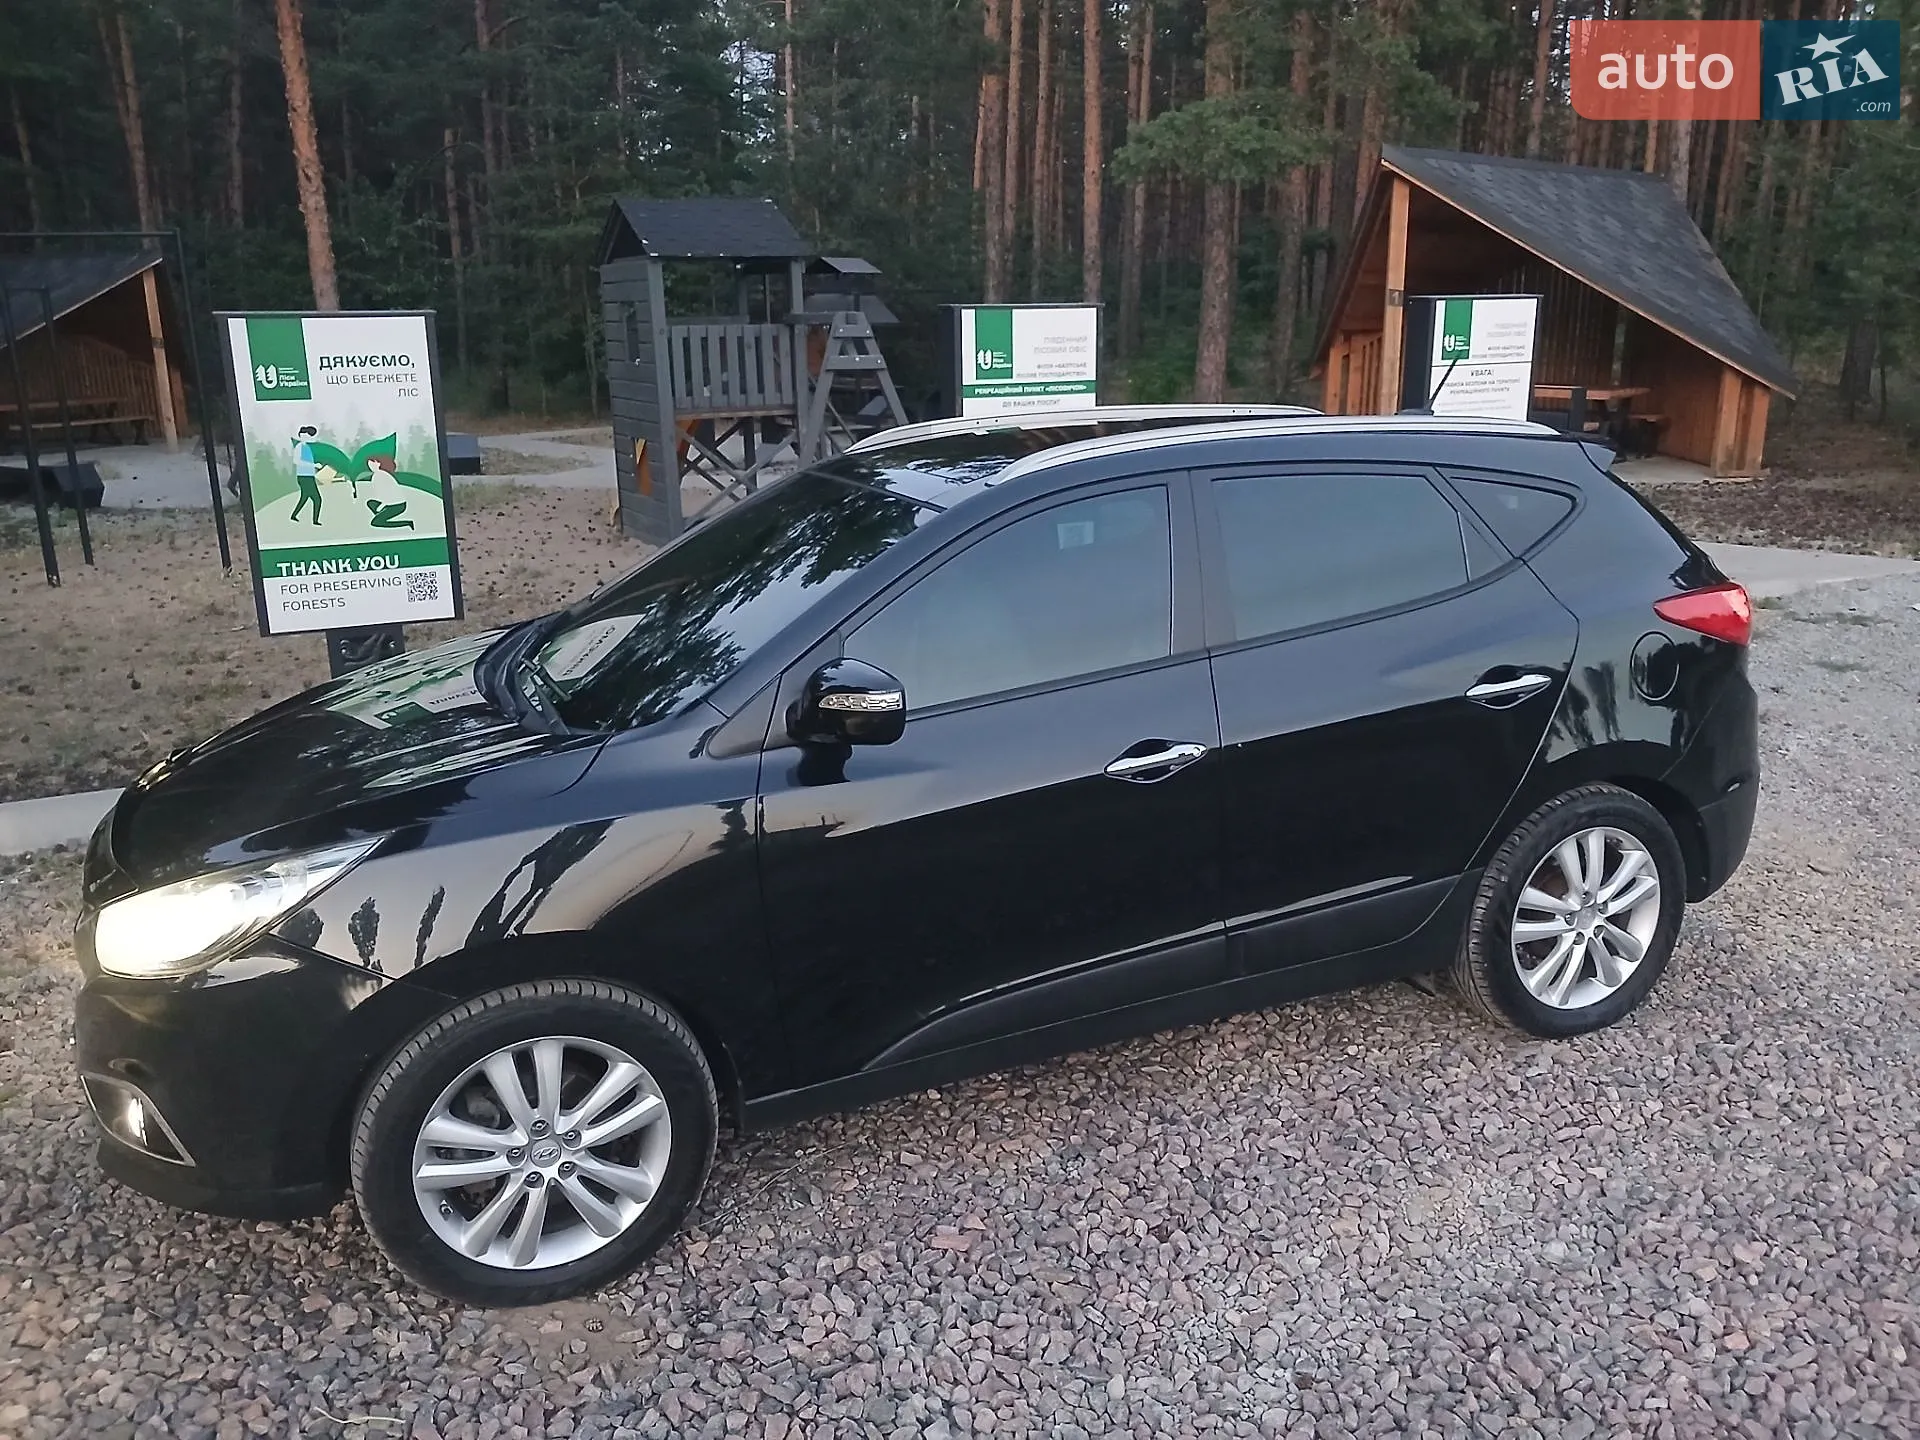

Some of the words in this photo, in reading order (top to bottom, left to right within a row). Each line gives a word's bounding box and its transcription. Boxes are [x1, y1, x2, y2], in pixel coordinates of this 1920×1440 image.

[319, 354, 416, 371] ДЯКУЄМО,
[326, 375, 349, 387] ЩО
[352, 373, 417, 384] БЕРЕЖЕТЕ
[398, 388, 419, 397] ЛІС
[276, 558, 353, 577] THANK
[357, 554, 400, 572] YOU
[280, 583, 309, 595] FOR
[314, 577, 402, 593] PRESERVING
[282, 597, 346, 612] FORESTS
